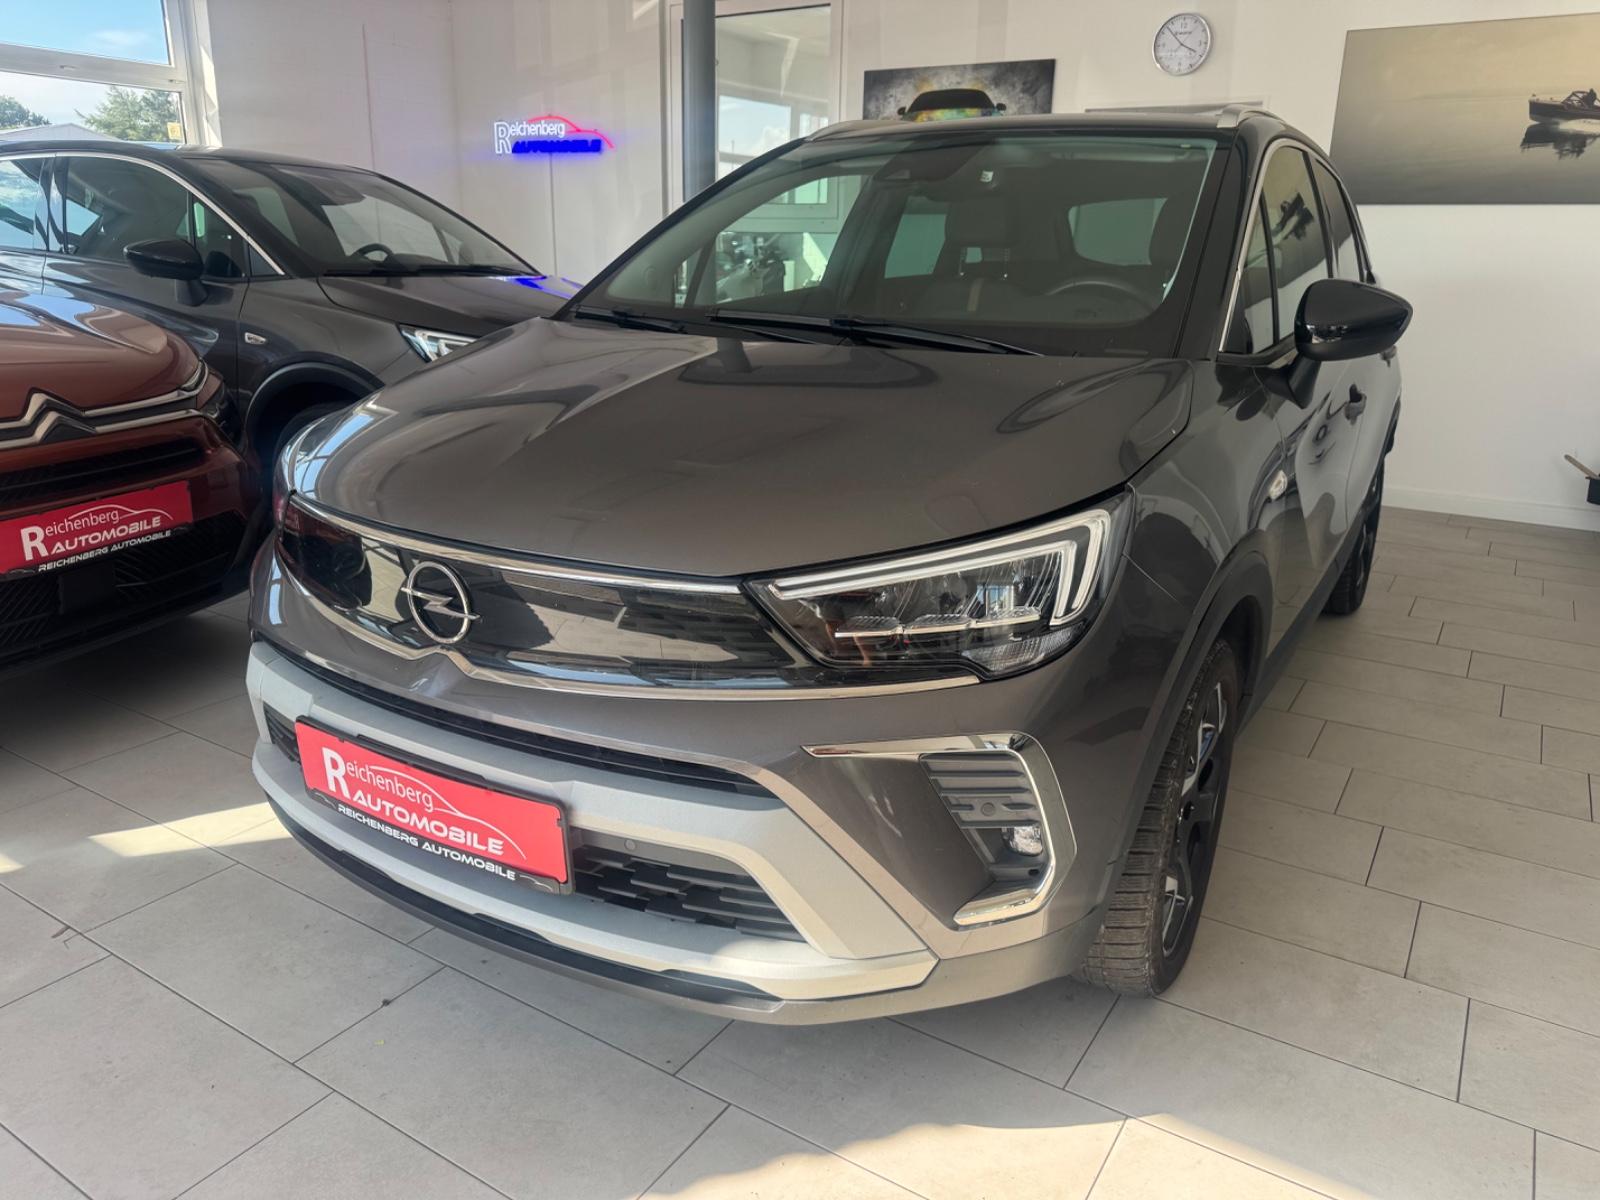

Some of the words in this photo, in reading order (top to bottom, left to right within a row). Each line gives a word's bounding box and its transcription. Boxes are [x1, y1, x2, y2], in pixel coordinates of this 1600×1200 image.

[494, 120, 565, 154] Reichenberg
[20, 510, 119, 561] Reichenberg
[38, 546, 108, 572] REICHENBERG
[110, 530, 171, 552] AUTOMOBILE
[51, 516, 161, 555] AUTOMOBILE
[322, 747, 434, 811] Reichenberg
[337, 804, 419, 847] REICHENBERG
[421, 842, 516, 880] AUTOMOBILE
[353, 790, 504, 856] AUTOMOBILE
